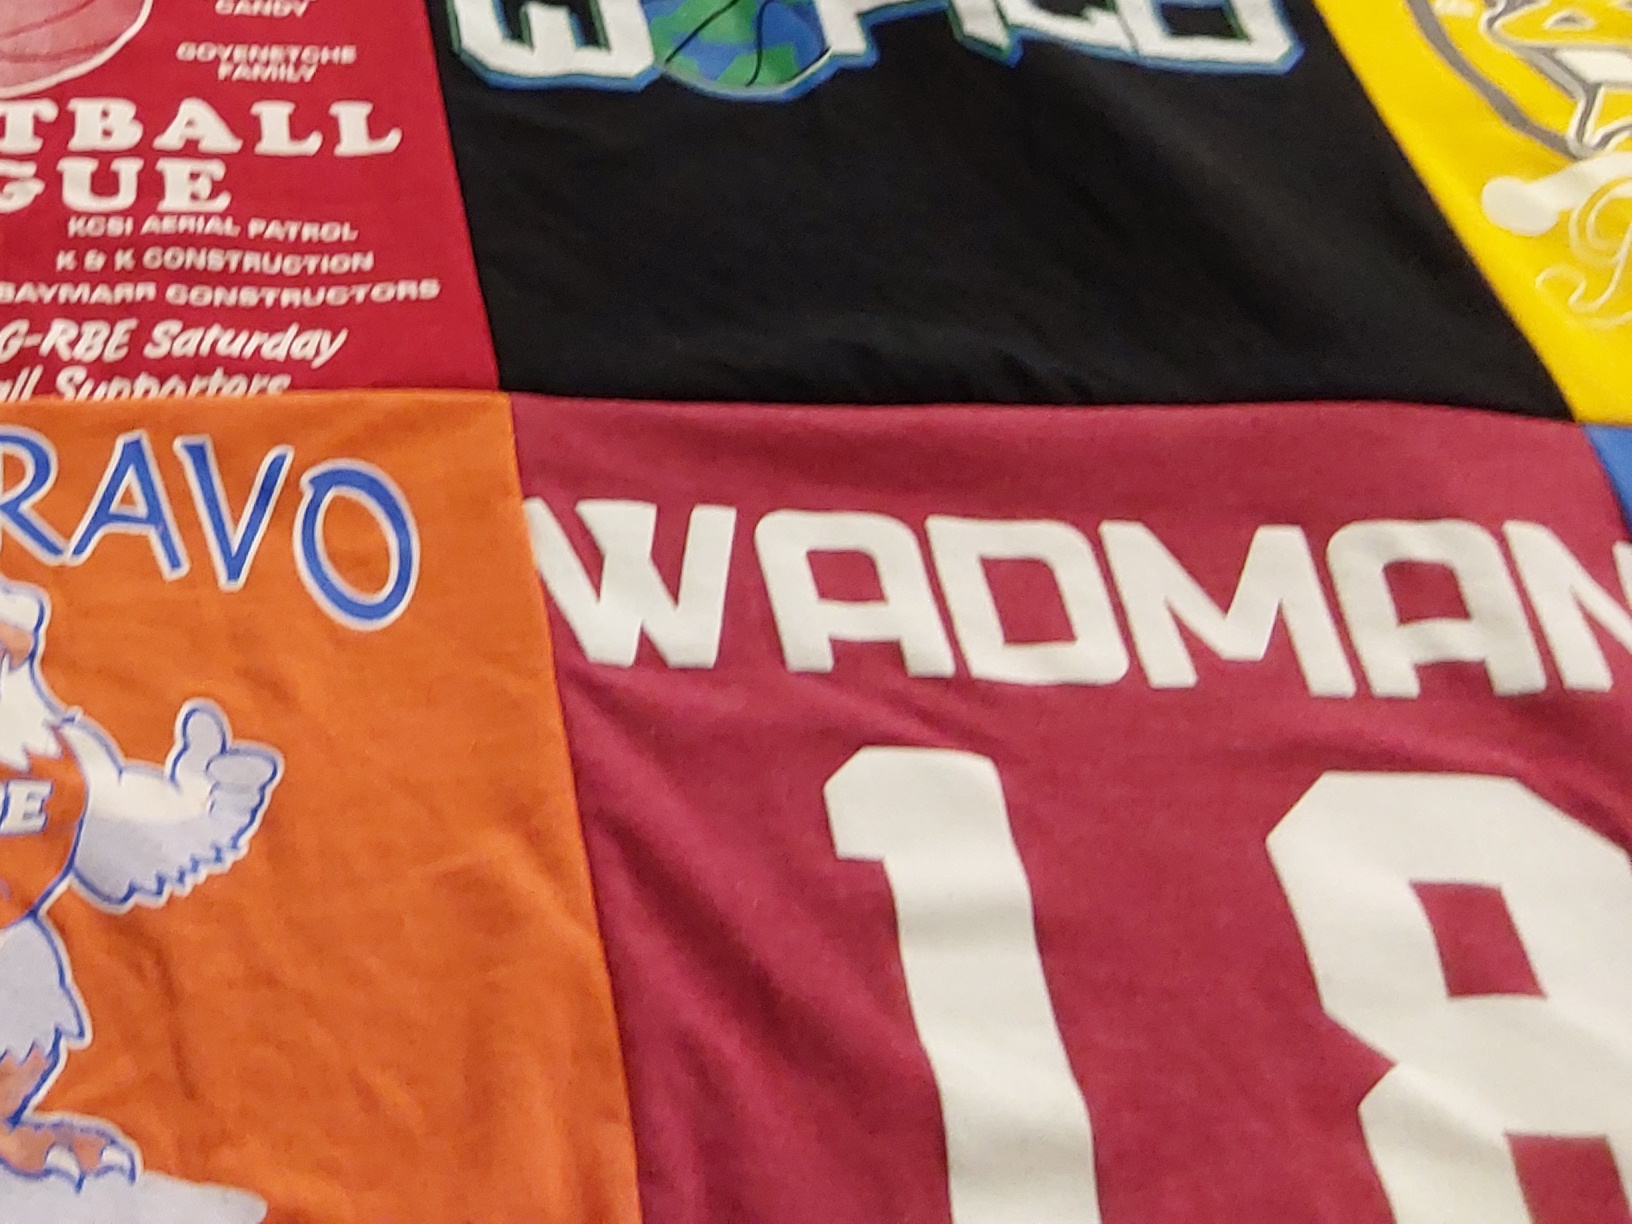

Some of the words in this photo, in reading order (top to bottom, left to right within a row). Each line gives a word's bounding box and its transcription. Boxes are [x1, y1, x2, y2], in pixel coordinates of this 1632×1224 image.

[219, 61, 318, 83] FAMILY
[140, 215, 241, 239] AERIAL
[247, 218, 359, 244] PATROL
[56, 249, 78, 273] K
[114, 248, 137, 273] K
[142, 246, 375, 276] CONSTRUCTION
[166, 278, 442, 310] CONSTRUCTORS
[142, 319, 349, 369] Saturday
[523, 497, 1632, 699] WADMAN
[823, 746, 1632, 1224] 18
